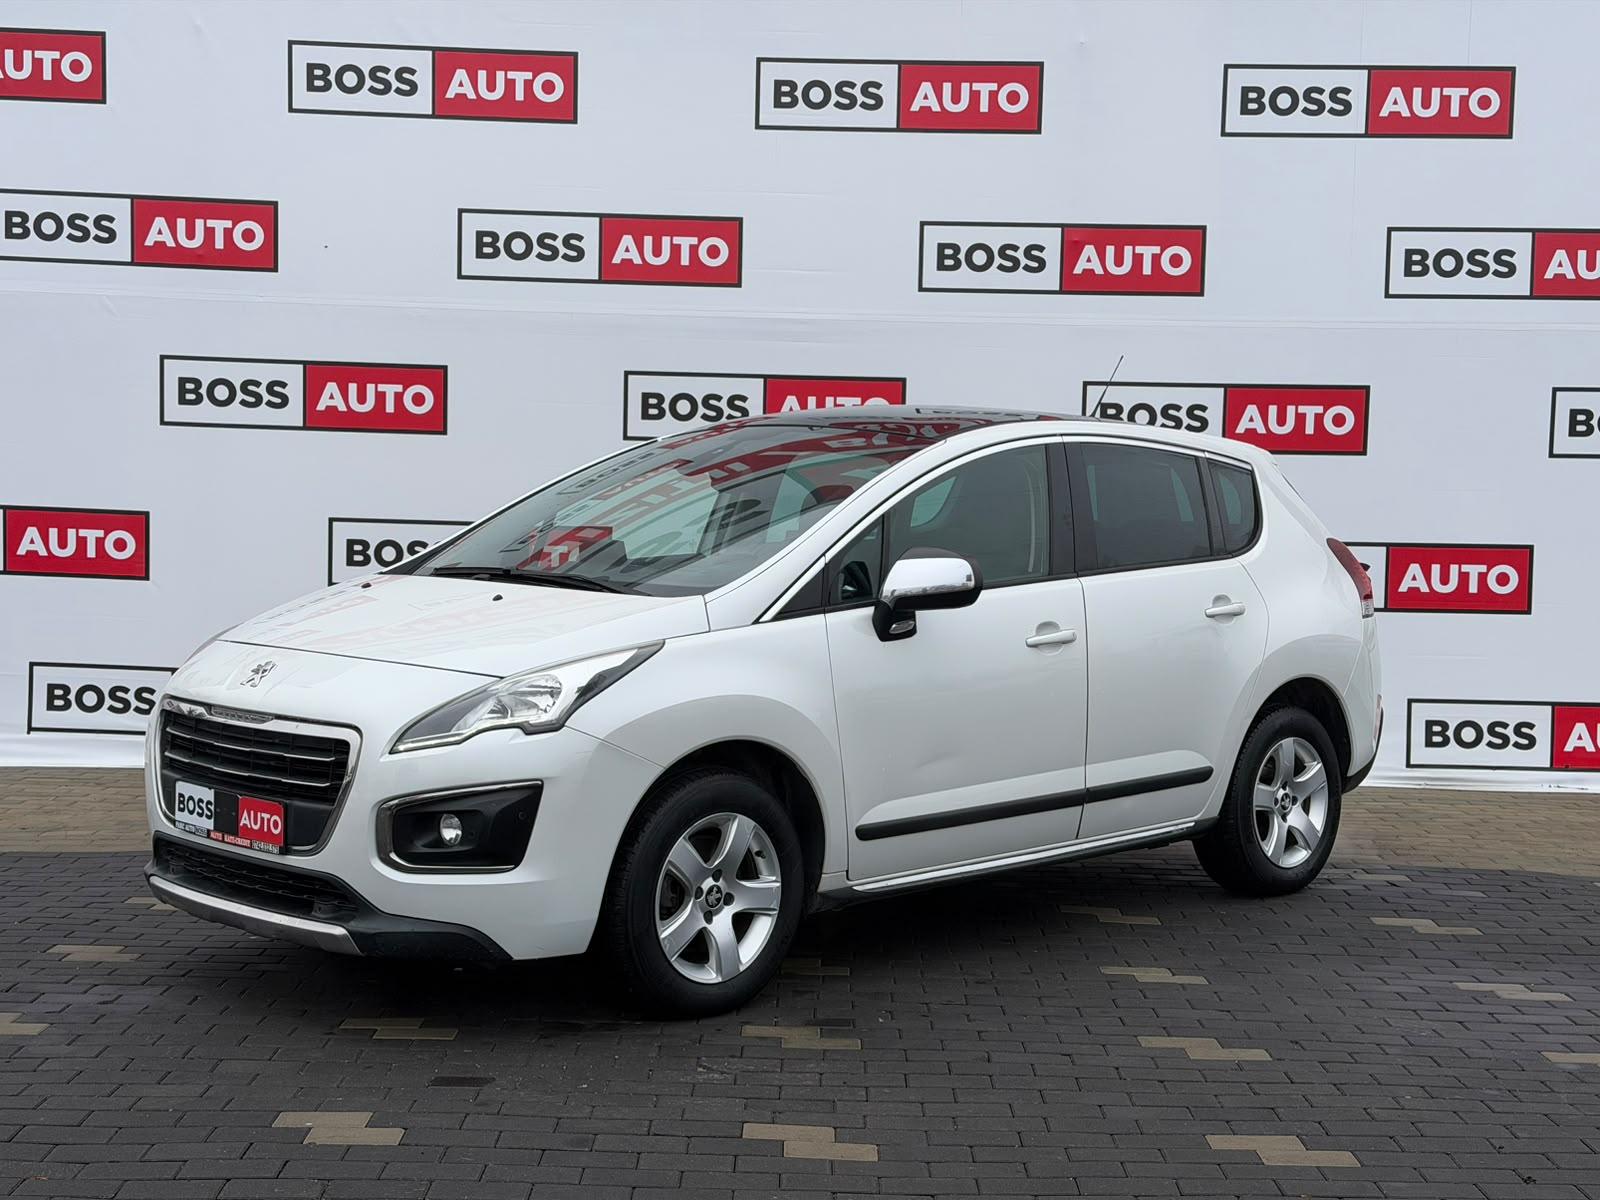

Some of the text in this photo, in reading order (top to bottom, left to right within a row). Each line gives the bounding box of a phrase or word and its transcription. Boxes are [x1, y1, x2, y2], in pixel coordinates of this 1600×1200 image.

[0, 49, 93, 82] UTO
[307, 63, 564, 102] BOSS AUTO
[774, 80, 1029, 113] BOSS AUTO
[1240, 86, 1500, 118] BOSS AUTO
[4, 211, 264, 251] BOSS AUTO
[476, 231, 730, 266] BOSS AUTO
[937, 243, 1192, 276] BOSS AUTO
[1404, 249, 1516, 278] BOSS
[178, 377, 434, 414] BOSS AUTO
[641, 392, 750, 422] BOSS
[1236, 405, 1355, 435] AUTO
[17, 527, 135, 559] AUTO
[1398, 564, 1518, 594] AUTO
[47, 684, 156, 715] BOSS
[1425, 720, 1536, 750] BOSS
[178, 793, 213, 820] BOSS
[240, 808, 281, 835] AUTO
